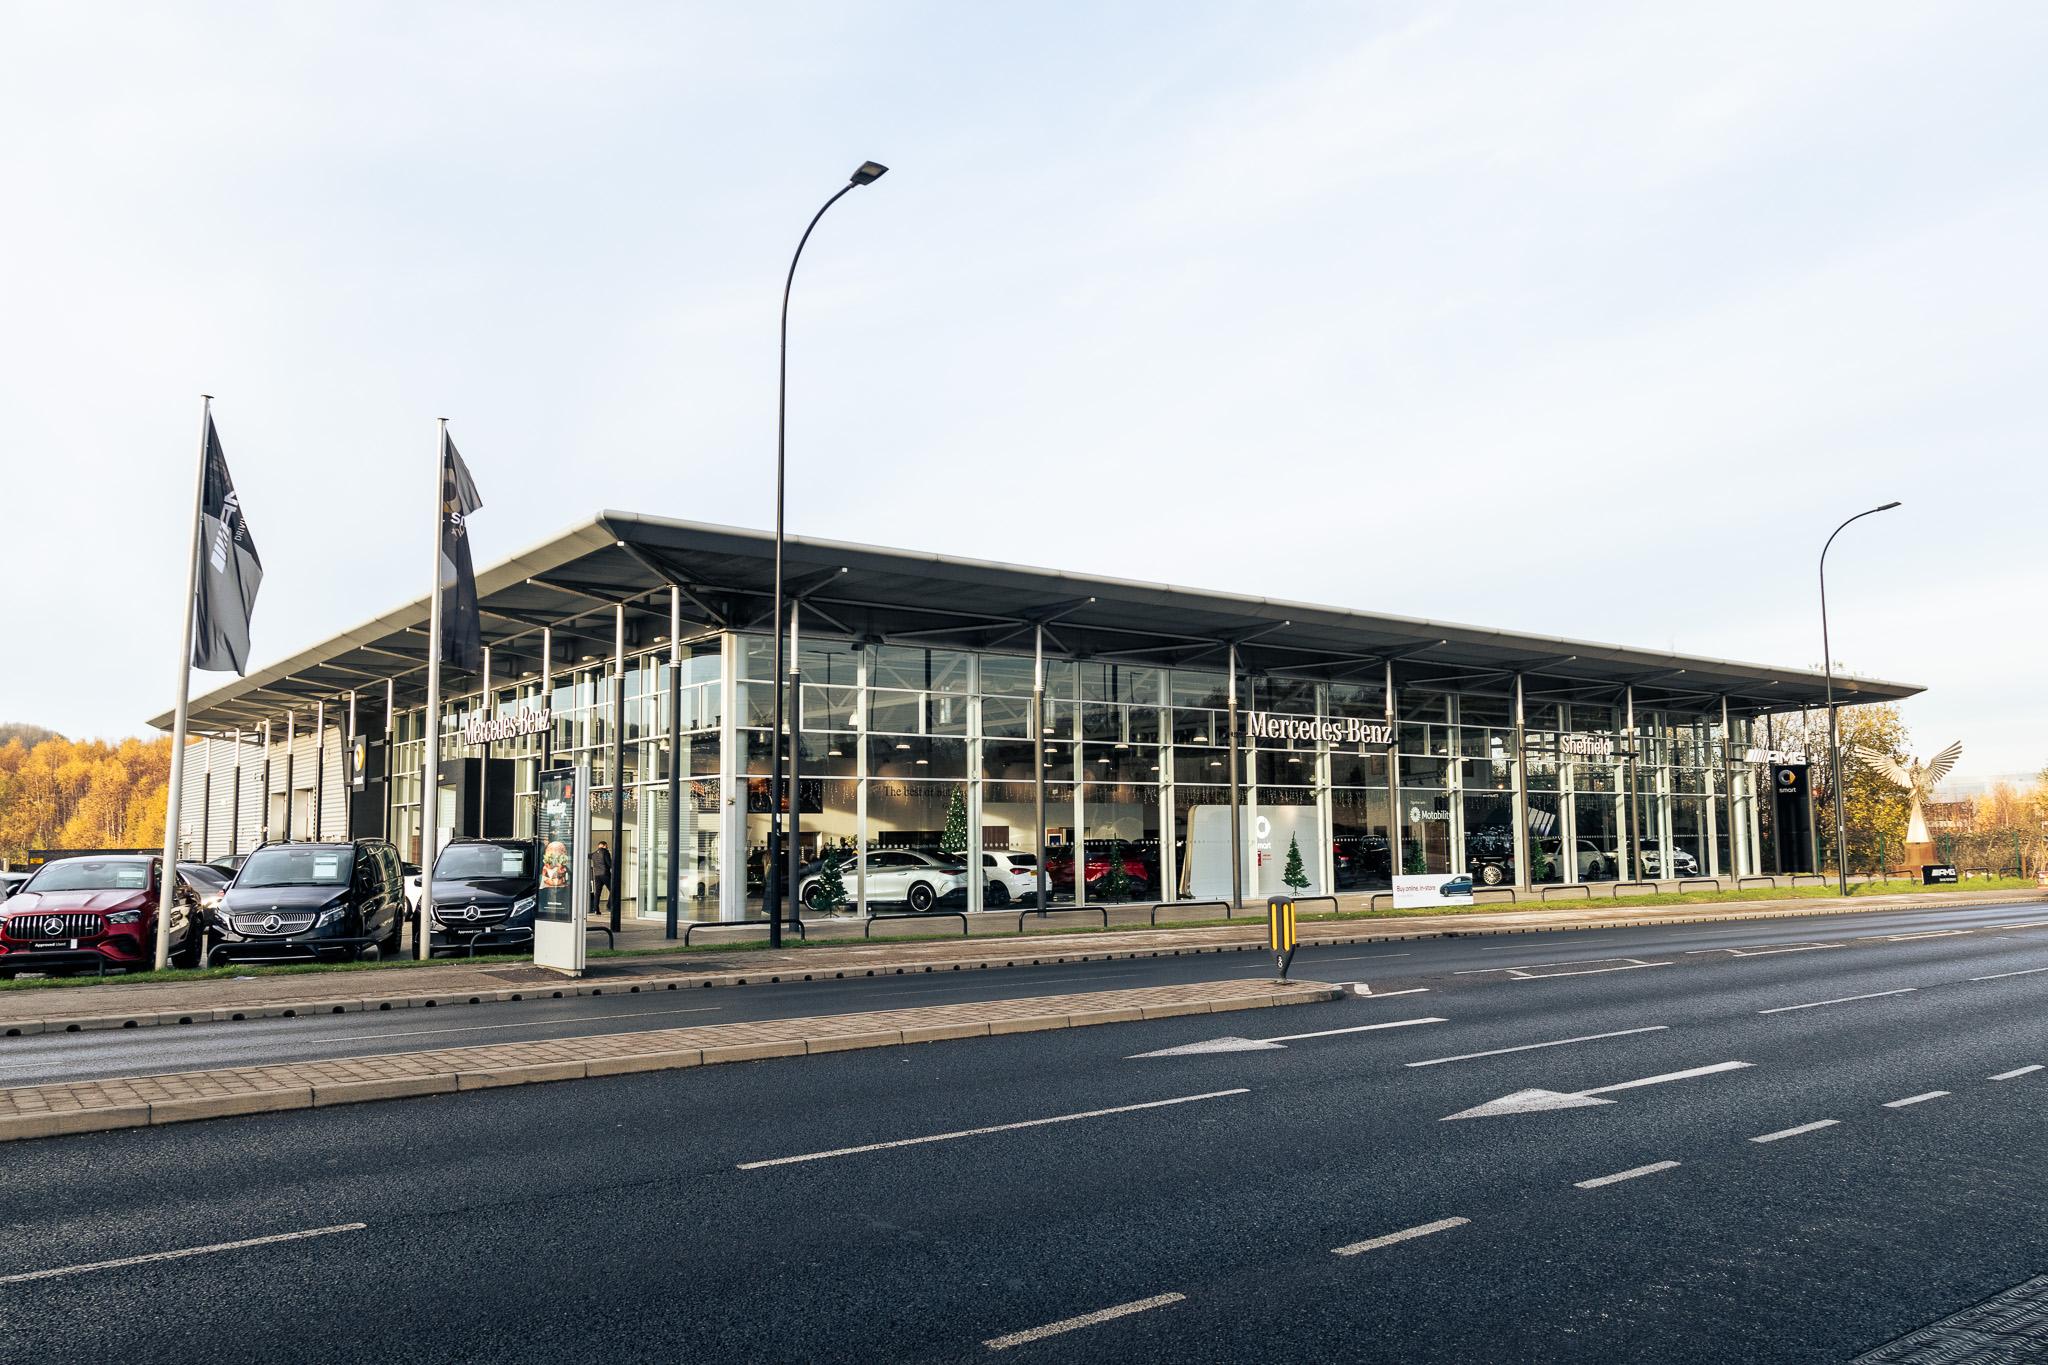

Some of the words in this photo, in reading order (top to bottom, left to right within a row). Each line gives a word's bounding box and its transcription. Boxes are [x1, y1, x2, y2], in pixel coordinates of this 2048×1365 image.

[464, 706, 552, 745] Mercedes-Benz
[1246, 711, 1393, 744] Mercedes-Benz
[1561, 735, 1611, 756] Sheffield
[883, 785, 902, 797] The
[1257, 842, 1271, 850] mart
